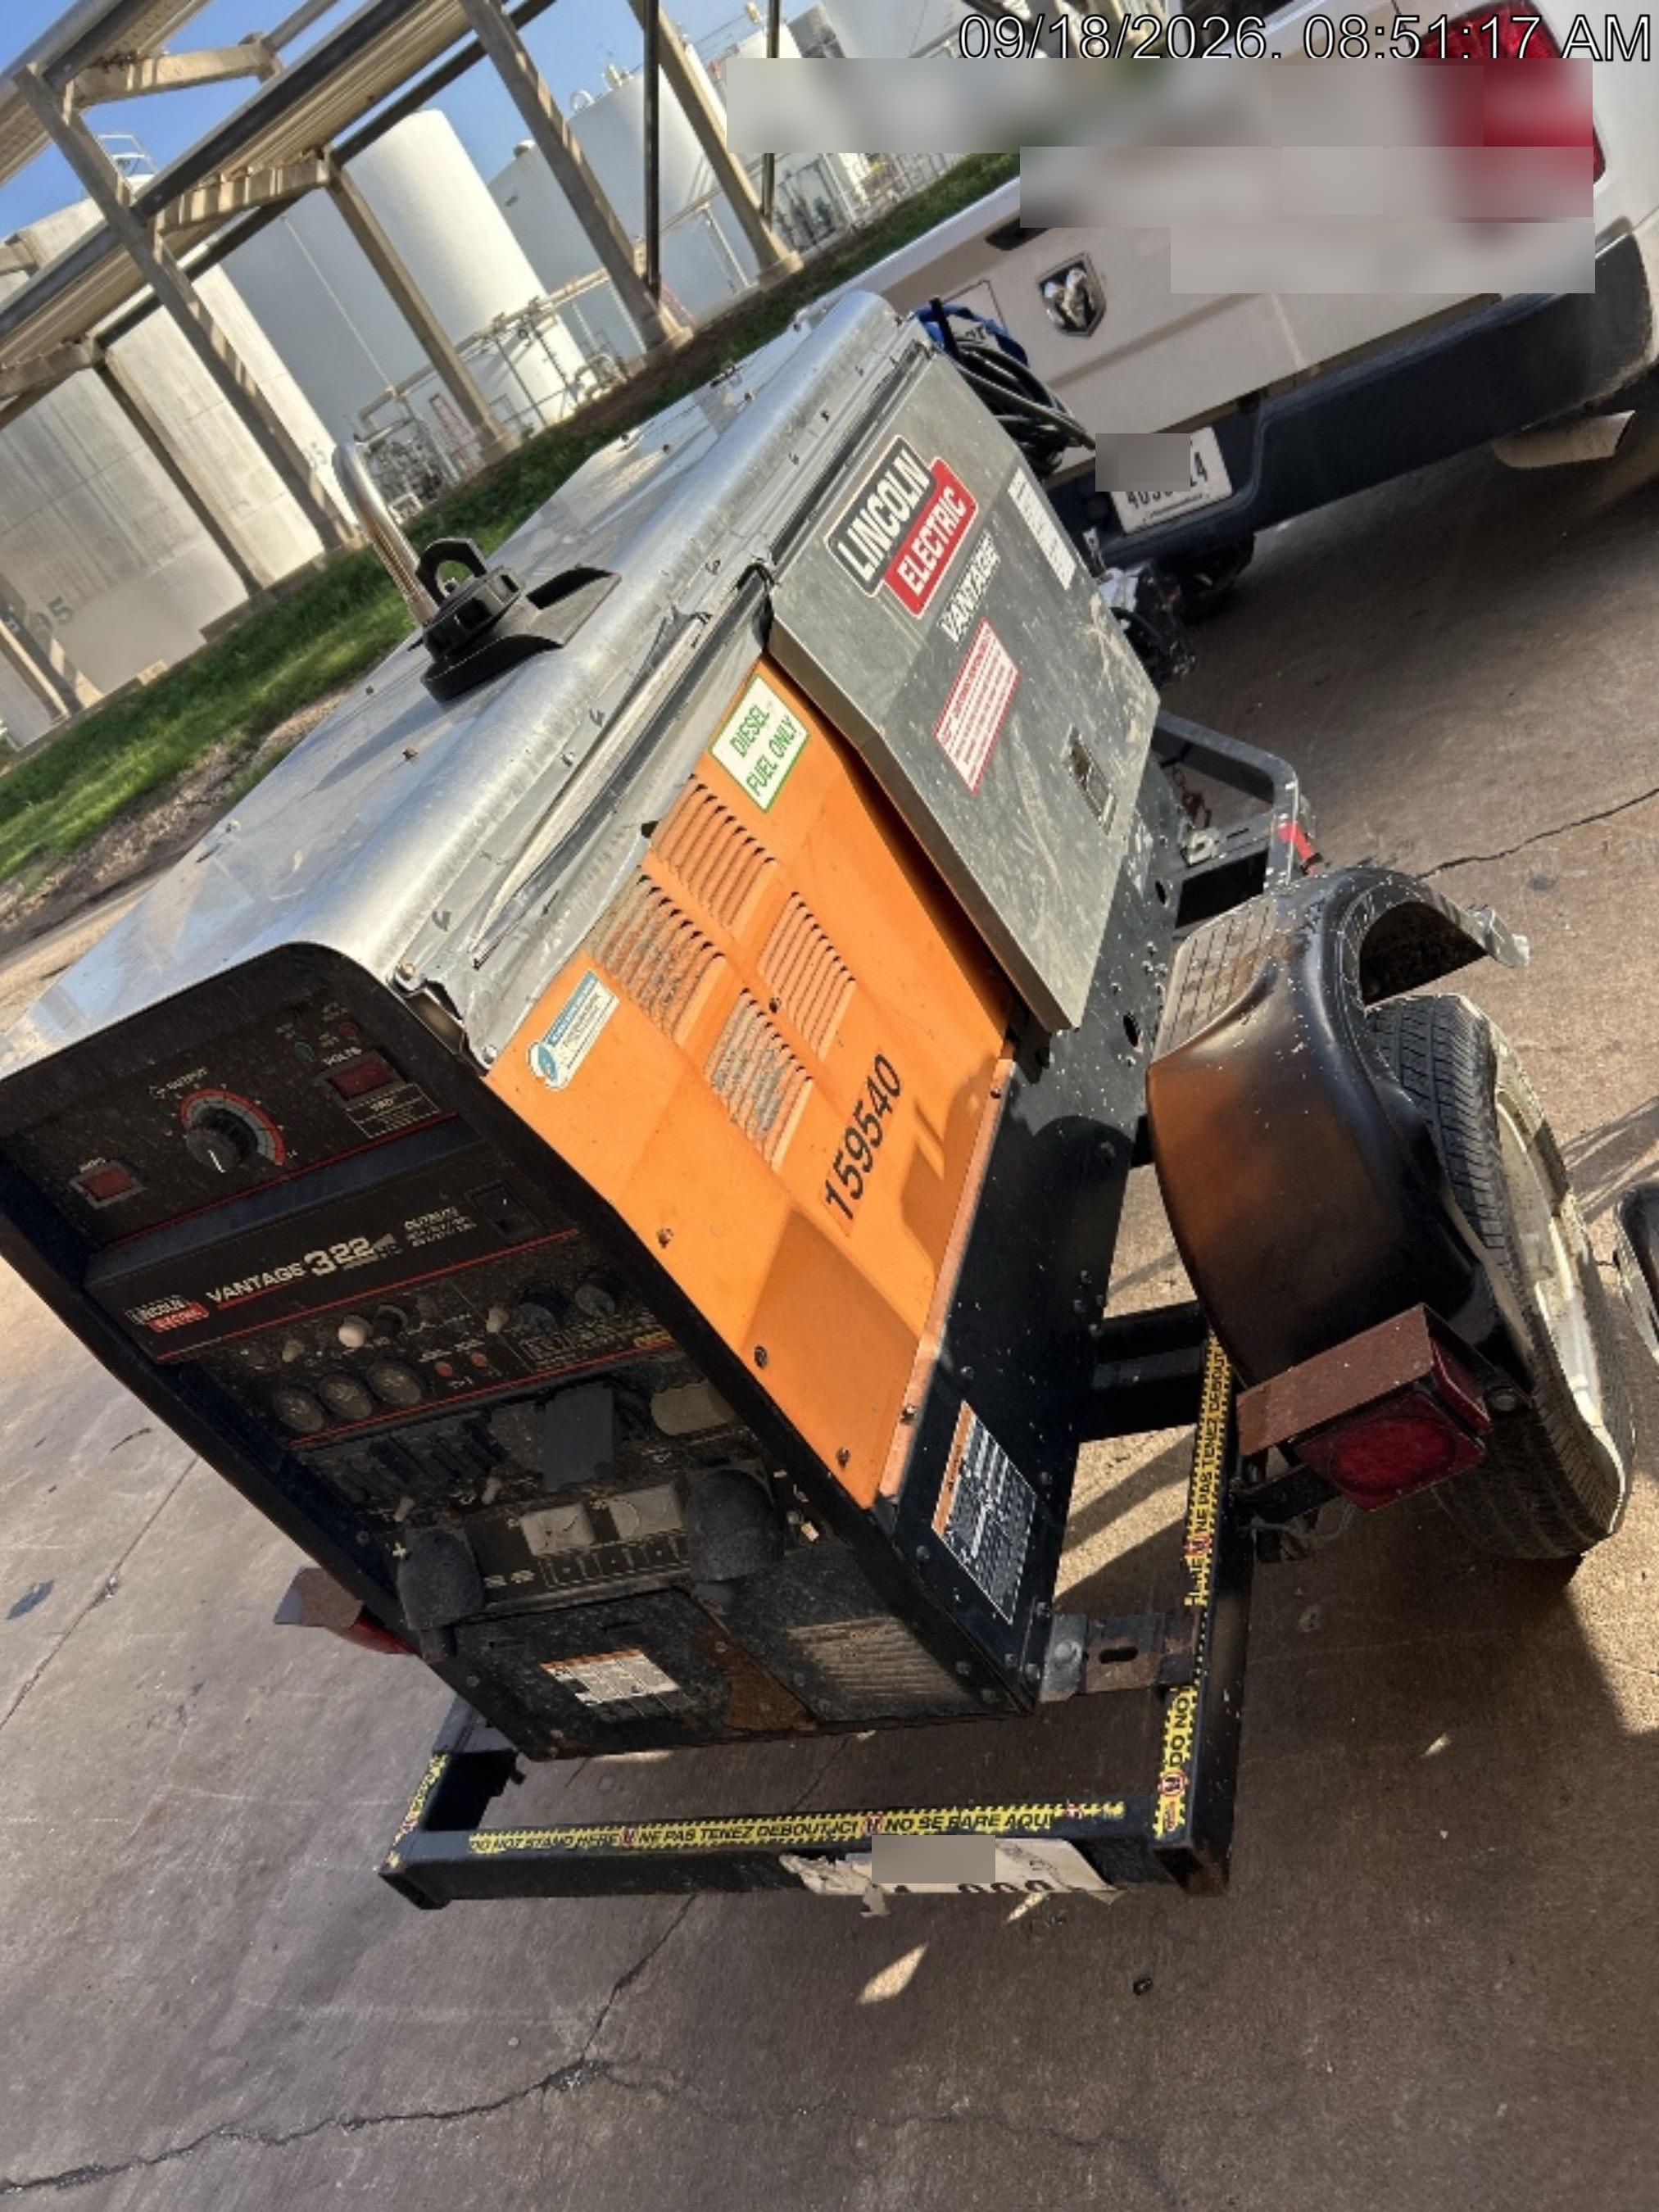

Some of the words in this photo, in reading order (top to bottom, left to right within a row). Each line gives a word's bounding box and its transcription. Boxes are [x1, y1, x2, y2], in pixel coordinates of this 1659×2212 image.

[837, 448, 931, 580] LINCOLN
[896, 487, 968, 596] ELECTRIC
[937, 530, 1001, 643] VANTAGE
[730, 705, 770, 758] DIESEL
[746, 755, 778, 796] FUEL
[768, 715, 798, 759] ONLY
[824, 1053, 903, 1222] 159540
[206, 1262, 306, 1304] VANTAGE
[304, 1238, 374, 1276] 322
[1198, 1472, 1213, 1504] PAS
[1170, 1734, 1185, 1766] DO
[523, 1835, 574, 1849] STAD
[638, 1829, 662, 1843] NE
[664, 1829, 696, 1842] PAS
[700, 1825, 755, 1839] TENEZ
[757, 1821, 832, 1837] DEBOUT
[885, 1818, 912, 1832] NO
[917, 1816, 944, 1830] SE
